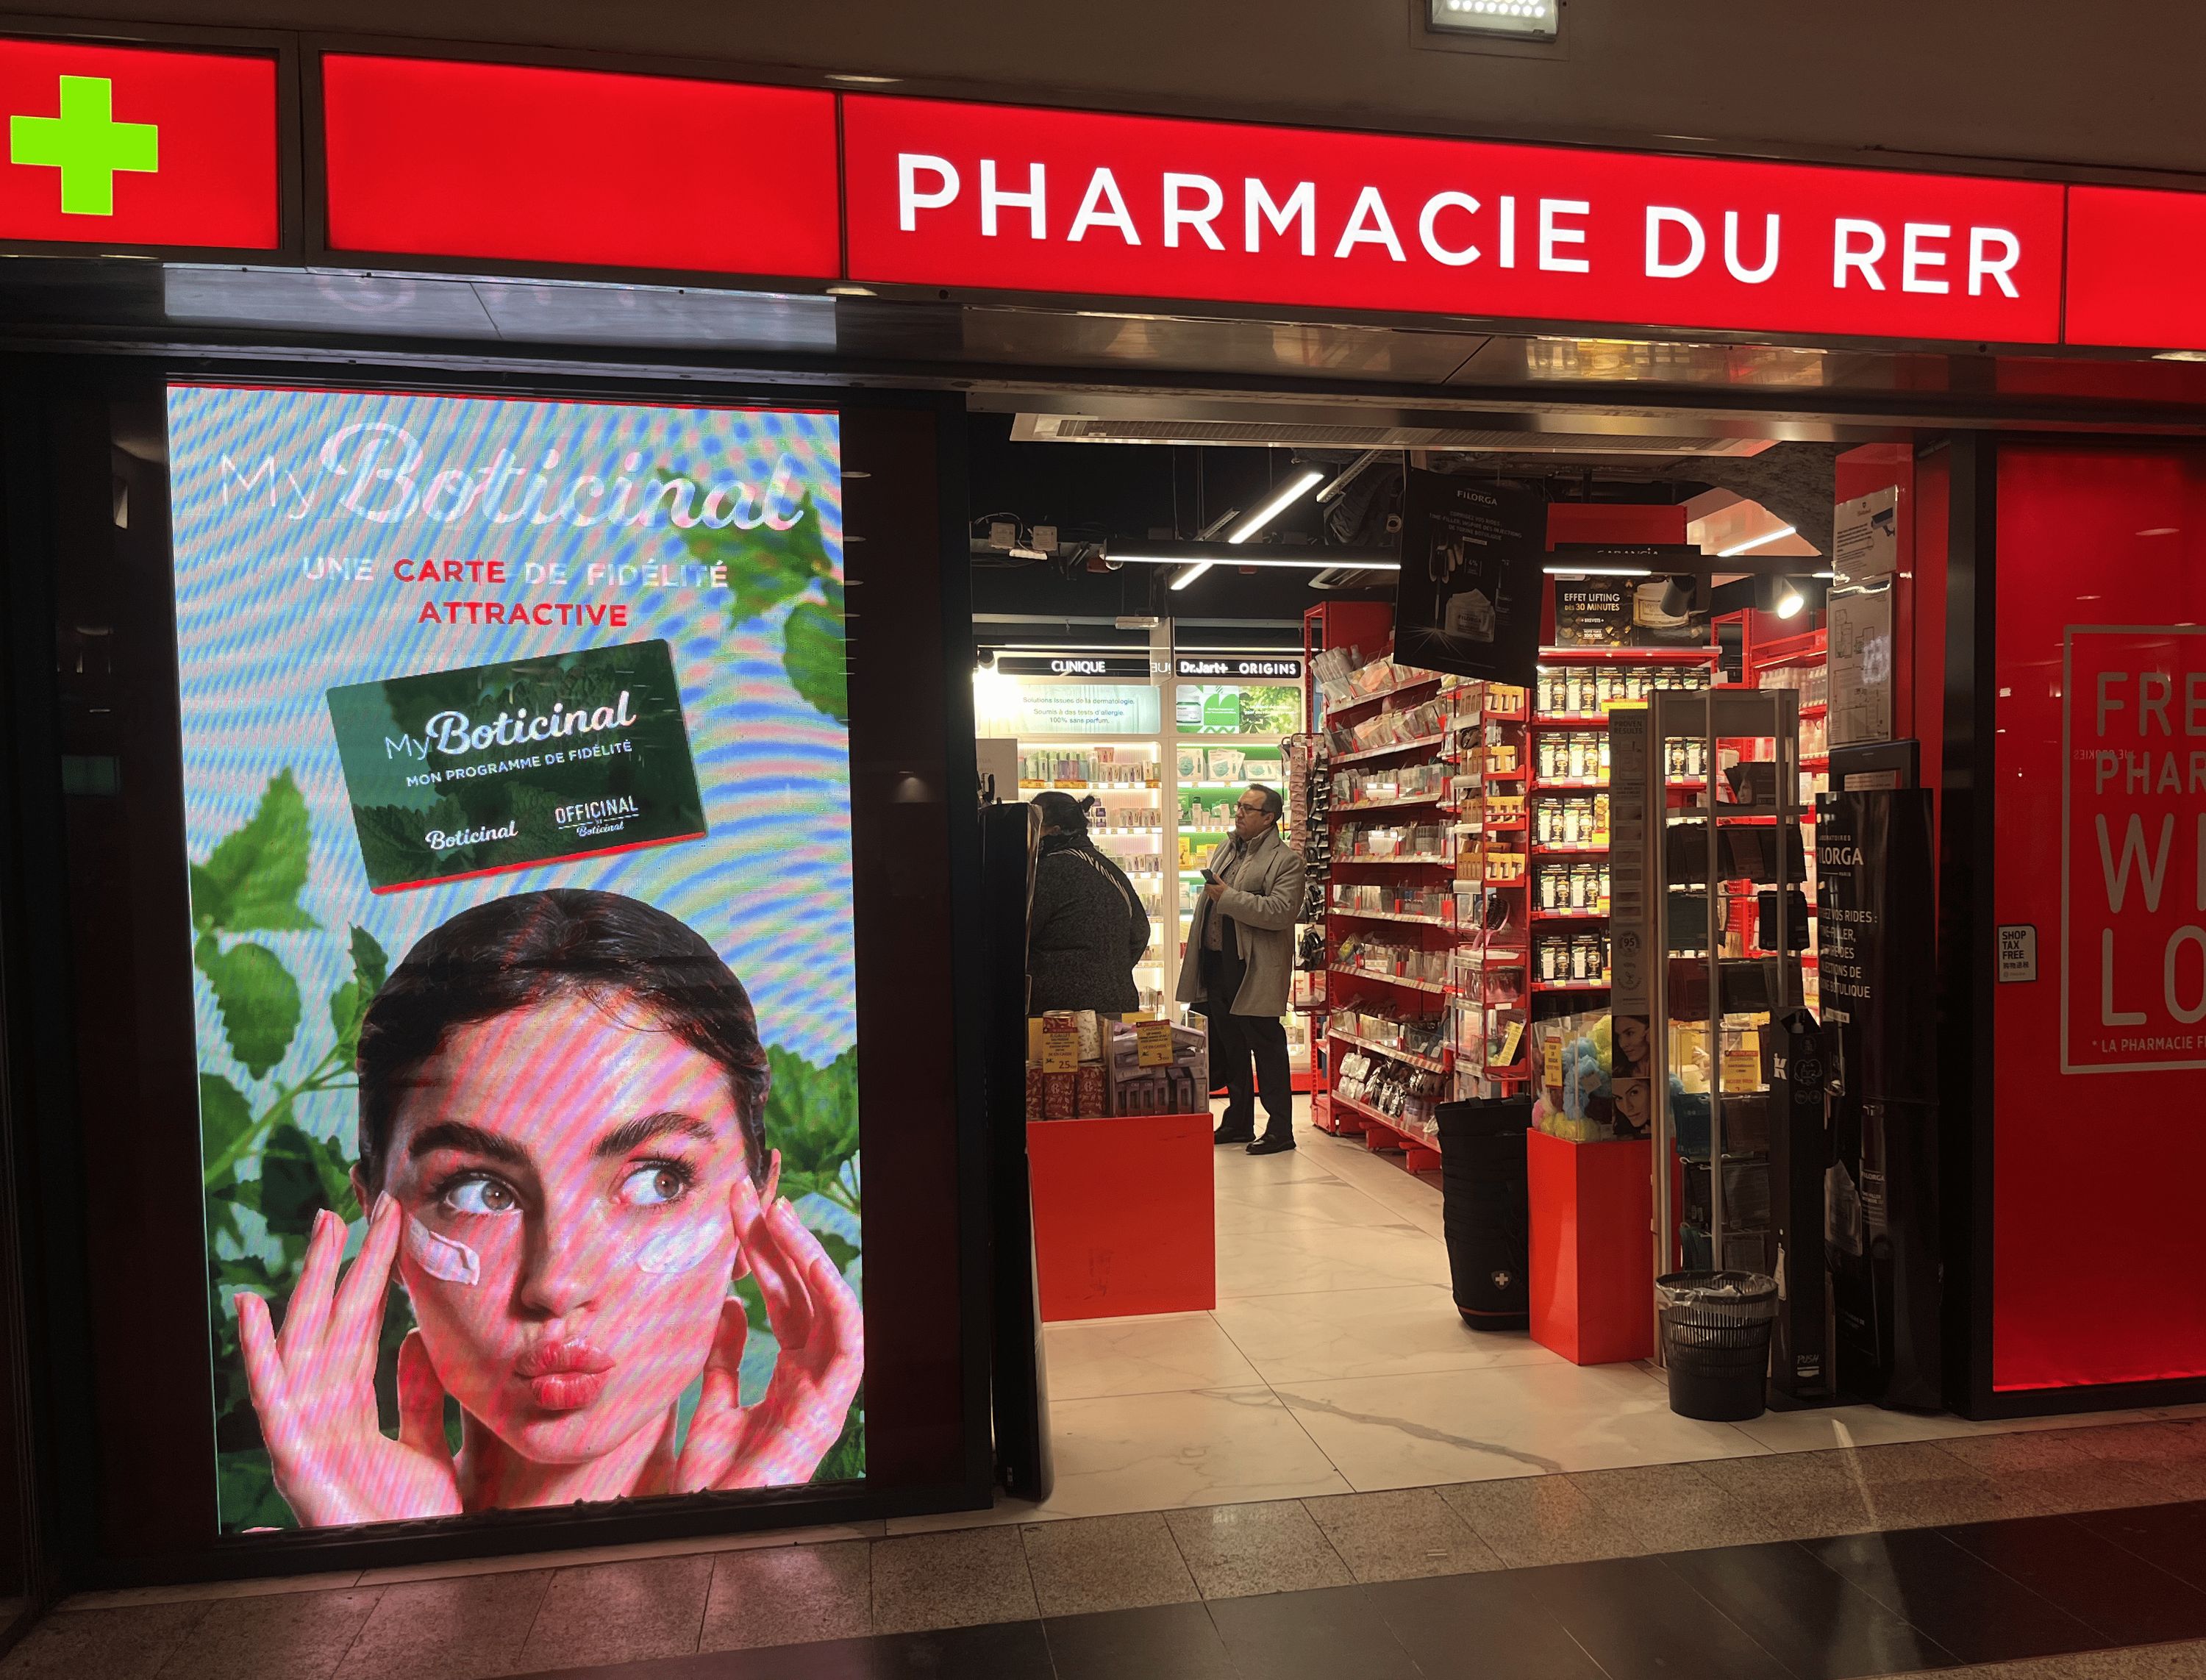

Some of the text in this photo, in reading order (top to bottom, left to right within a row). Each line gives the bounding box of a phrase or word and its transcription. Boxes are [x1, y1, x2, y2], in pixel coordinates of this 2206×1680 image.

[898, 152, 2021, 299] PHARMACIE DU RER
[1457, 490, 1498, 506] FILORGA
[302, 557, 729, 588] UNE CARTE DE FIDÉLITÉ
[1564, 593, 1620, 602] EFFET LIFTING
[417, 601, 628, 627] ATTRACTIVE
[1576, 603, 1585, 611] 30
[1587, 603, 1620, 612] MINUTES
[1051, 660, 1106, 674] CLINIQUE
[1180, 662, 1229, 674] Dr.Jart+
[1238, 662, 1296, 675] ORIGINS
[1093, 697, 1135, 705] dermatologie.
[1085, 717, 1110, 725] parfum.
[406, 739, 633, 787] MON PROGRAMME DE FIDÉLITÉ
[554, 795, 640, 824] OFFICINAL
[425, 820, 519, 851] Boticinal
[577, 821, 625, 837] Boticinal
[1844, 909, 1873, 923] RIDES
[2002, 930, 2027, 940] SHOP
[2002, 940, 2019, 950] TAX
[1839, 946, 1855, 959] DES
[2002, 950, 2024, 959] FREE
[1849, 965, 1862, 979] DE
[2101, 1039, 2118, 1054] LA
[2121, 1035, 2193, 1052] PHARMACIE
[1796, 1354, 1820, 1365] PUSH
